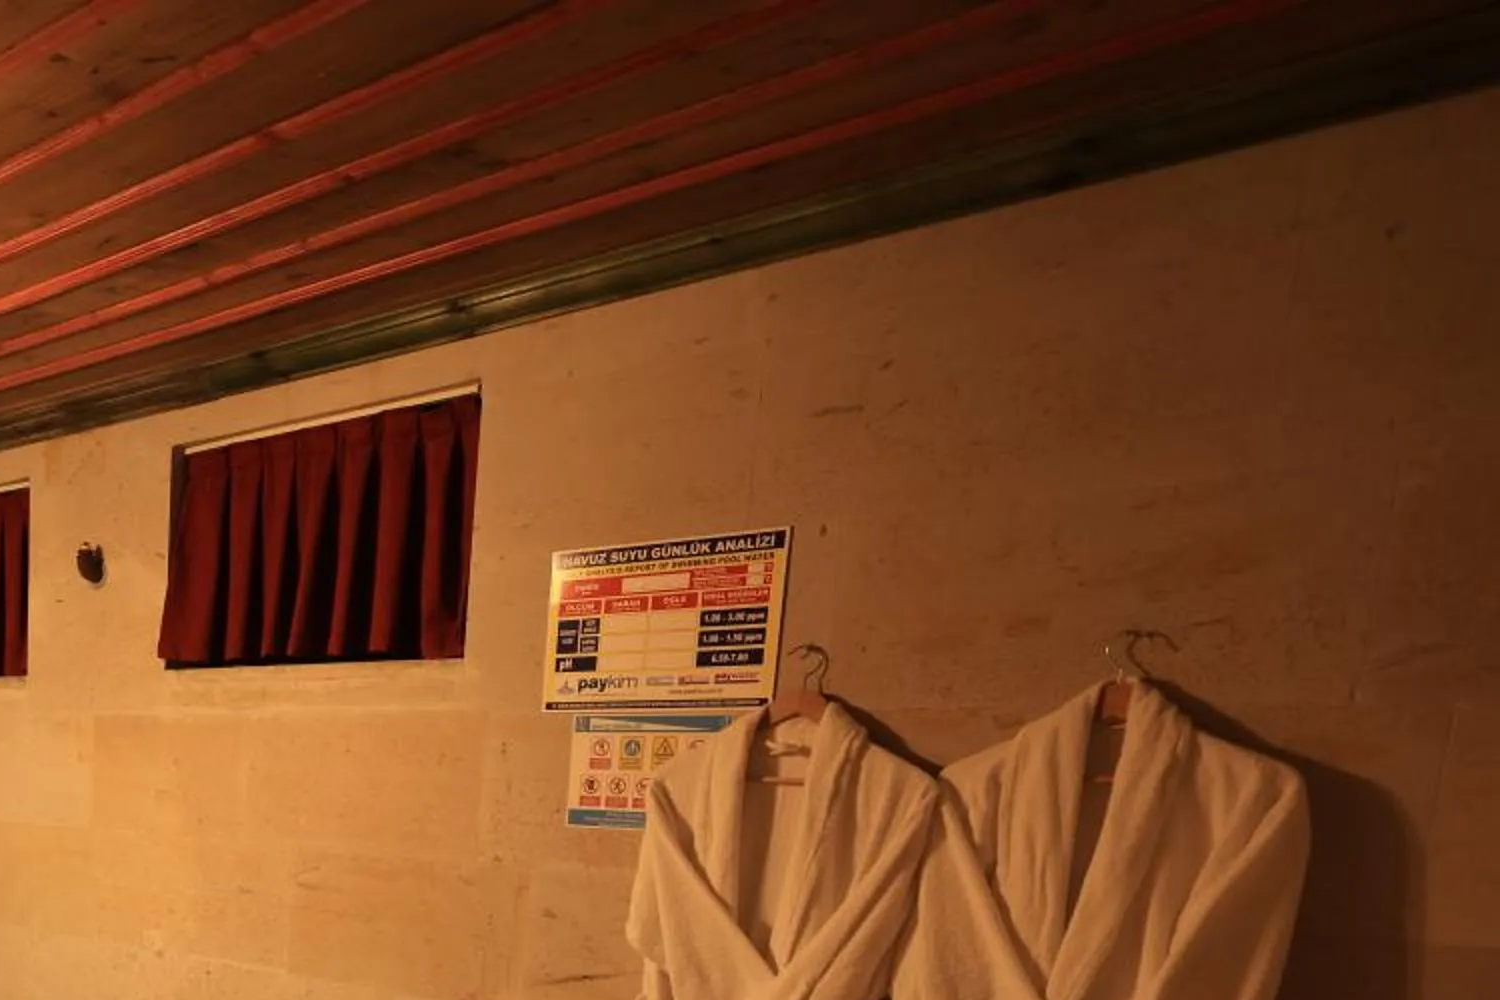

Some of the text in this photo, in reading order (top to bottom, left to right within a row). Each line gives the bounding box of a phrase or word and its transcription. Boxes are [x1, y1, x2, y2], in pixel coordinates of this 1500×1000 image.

[610, 549, 647, 563] SUYU
[559, 658, 573, 671] pH
[578, 674, 639, 693] paykim
